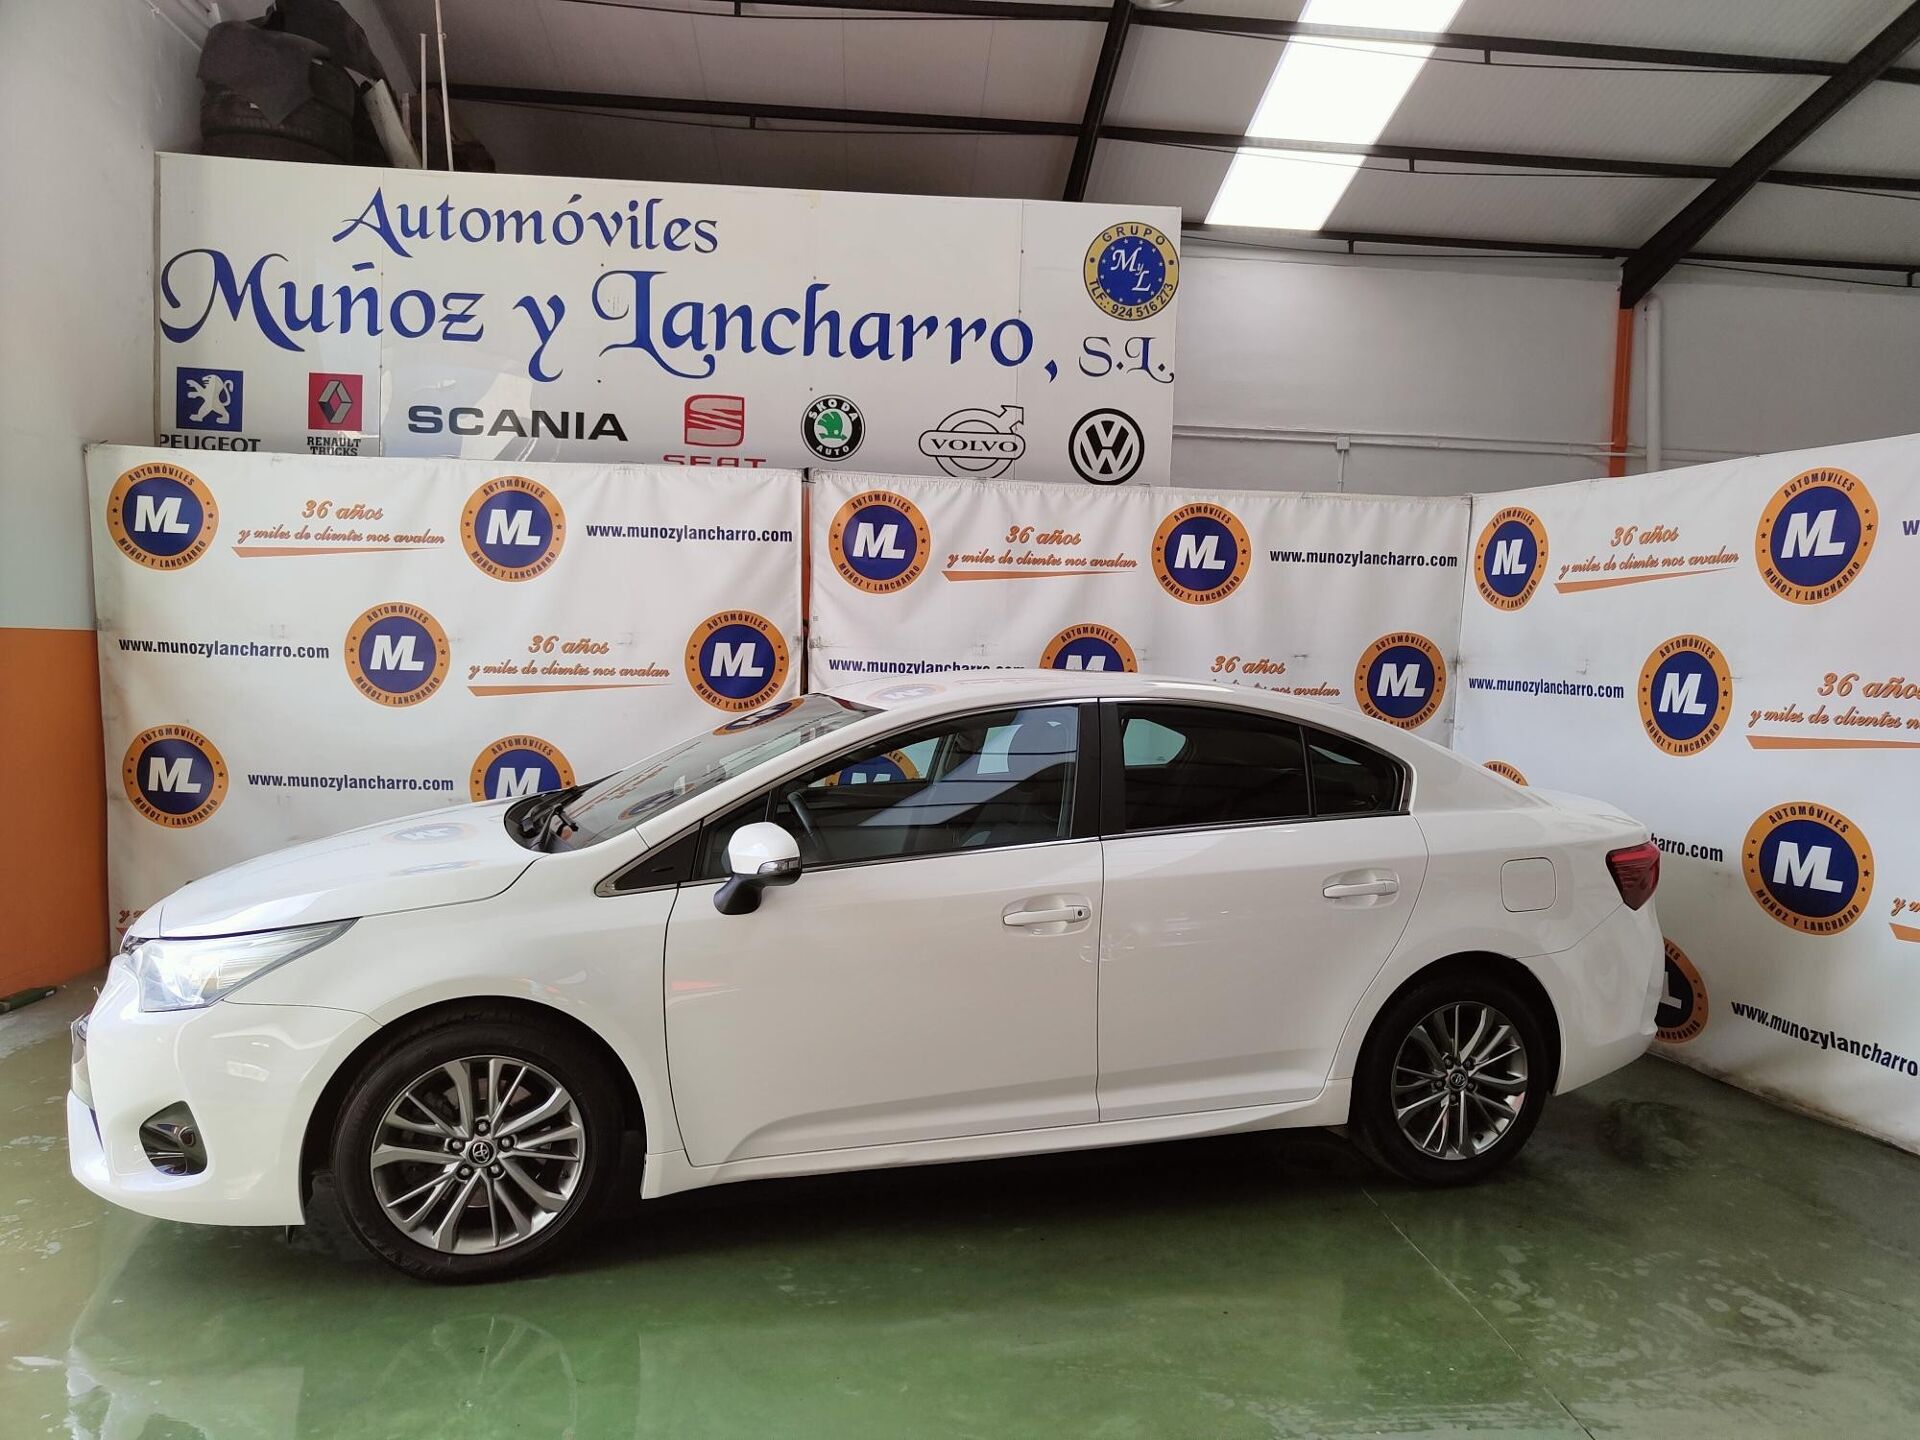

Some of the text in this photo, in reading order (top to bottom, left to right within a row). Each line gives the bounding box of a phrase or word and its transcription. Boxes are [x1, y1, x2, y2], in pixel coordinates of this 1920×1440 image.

[333, 186, 718, 258] Automóviles
[1102, 225, 1165, 246] GRUPO
[1110, 304, 1133, 318] 924
[1136, 301, 1158, 318] 516
[1156, 282, 1174, 305] 273
[160, 249, 1174, 384] Muñoz y Lancharro, S.L.
[407, 405, 629, 442] SCANIA
[160, 434, 261, 451] PEUGEOT
[307, 436, 361, 448] RENAULT
[310, 446, 357, 457] TRUCKS
[816, 445, 850, 456] AUTO
[930, 437, 1019, 453] VOLVO
[128, 464, 195, 486] AUTOMÓVILES
[1784, 471, 1856, 499] AUTOMÓVILES
[483, 479, 546, 499] AUTOMÓVILES
[134, 495, 190, 534] ML
[302, 500, 384, 521] 36 años
[851, 492, 912, 513] AUTOMÓVILES
[1174, 504, 1232, 525] AUTOMÓVILES
[485, 509, 542, 546] ML
[1492, 510, 1535, 529] AUTOMÓVILES
[238, 524, 445, 544] y miles de clientes nos avalan
[586, 523, 793, 543] www.munozylancharro.com
[852, 522, 906, 560] ML
[1005, 525, 1082, 546] 36 años
[1610, 524, 1680, 548] 36 años
[1780, 509, 1846, 559] ML
[117, 536, 148, 564] MUÑOZ
[159, 540, 207, 568] LANCHARRO
[471, 550, 497, 575] MUÑOZ
[509, 551, 556, 579] LANCHARRO
[947, 549, 1138, 569] y miles de clientes nos avalan
[1174, 534, 1226, 570] ML
[1269, 550, 1458, 567] www.munozylancharro.com
[1491, 538, 1528, 576] ML
[1560, 546, 1739, 580] y miles de clientes nos avalan
[837, 563, 863, 588] MUÑOZ
[874, 565, 921, 592] LANCHARRO
[1159, 575, 1185, 598] MUÑOZ
[1195, 575, 1240, 602] LANCHARRO
[1764, 567, 1792, 597] MUÑOZ
[1804, 561, 1860, 601] LANCHARRO
[1479, 581, 1497, 604] MUÑOZ
[1507, 579, 1537, 609] LANCHARRO
[366, 605, 429, 624] AUTOMÓVILES
[706, 612, 768, 632] AUTOMÓVILES
[528, 635, 610, 655] 36 años
[1060, 626, 1119, 645] AUTOMÓVILES
[1375, 635, 1432, 652] AUTOMÓVILES
[1659, 637, 1716, 660] AUTOMÓVILES
[119, 638, 329, 660] www.munozylancharro.com
[370, 635, 424, 671] ML
[710, 642, 764, 678] ML
[468, 659, 670, 680] y miles de clientes nos avalan
[1211, 655, 1286, 674] 36 años
[356, 676, 381, 700] MUÑOZ
[393, 677, 439, 704] LANCHARRO
[1293, 682, 1340, 696] avalan
[1376, 663, 1426, 698] ML
[1468, 676, 1625, 700] www.munozylancharro.com
[1658, 672, 1707, 715] ML
[1817, 672, 1920, 700] 36 año
[695, 683, 721, 705] MUÑOZ
[733, 682, 778, 710] LANCHARRO
[1396, 702, 1436, 729] LANCHARRO
[1748, 709, 1761, 728] y
[1764, 704, 1804, 724] miles
[1808, 705, 1829, 724] de
[1833, 706, 1902, 729] clientes
[140, 727, 206, 748] AUTOMÓVILES
[491, 738, 553, 756] AUTOMÓVILES
[1646, 719, 1665, 746] MUÑOZ
[1674, 723, 1721, 754] LANCHARRO
[147, 757, 202, 793] ML
[247, 771, 454, 792] www.munozylancharro.com
[133, 796, 161, 821] MUÑOZ
[171, 797, 219, 826] LANCHARRO
[1768, 806, 1850, 833] AUTOMÓVILES
[1772, 840, 1844, 894] ML
[1755, 888, 1788, 922] MUÑOZ
[1803, 904, 1860, 932] LANCHARRO
[1731, 1001, 1920, 1076] www.munozylancharro
